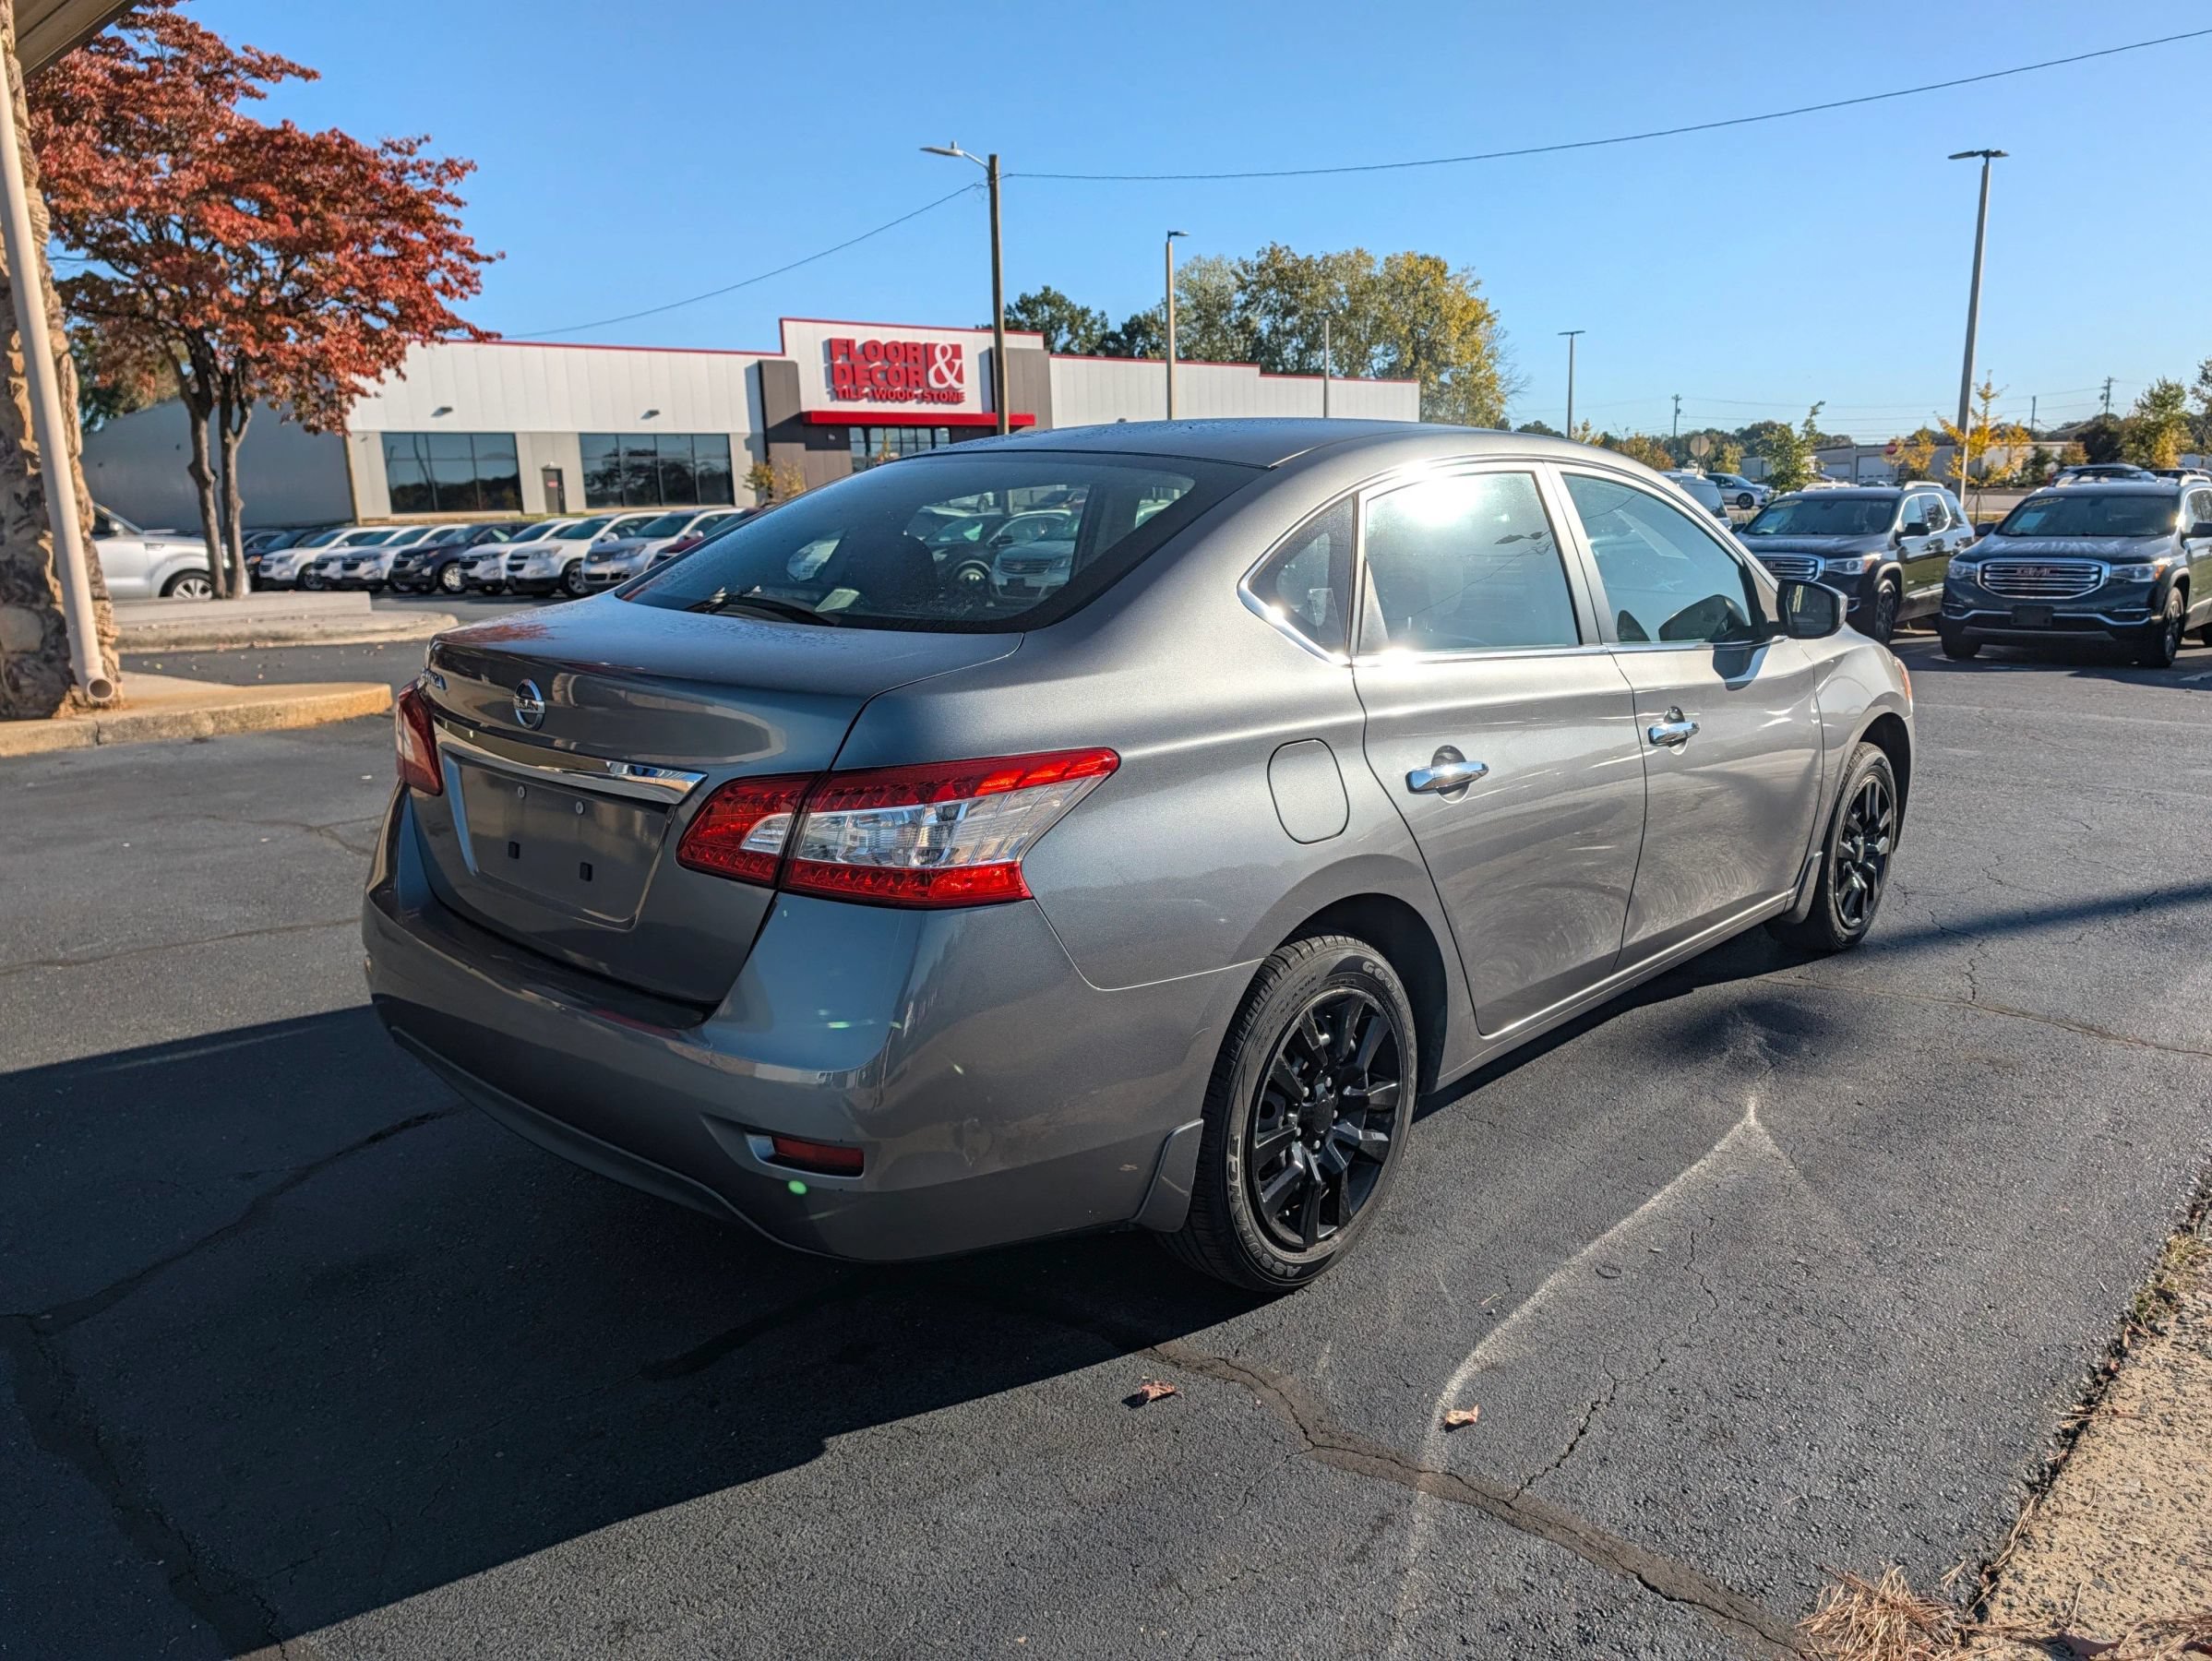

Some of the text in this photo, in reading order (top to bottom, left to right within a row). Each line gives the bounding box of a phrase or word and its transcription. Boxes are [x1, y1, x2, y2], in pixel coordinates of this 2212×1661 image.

[830, 338, 965, 389] FLOOR &
[831, 362, 927, 388] DECOR
[835, 387, 965, 404] TILE WOOD STONE
[2015, 566, 2060, 578] GMC
[1227, 1132, 1303, 1279] ASSURANCE
